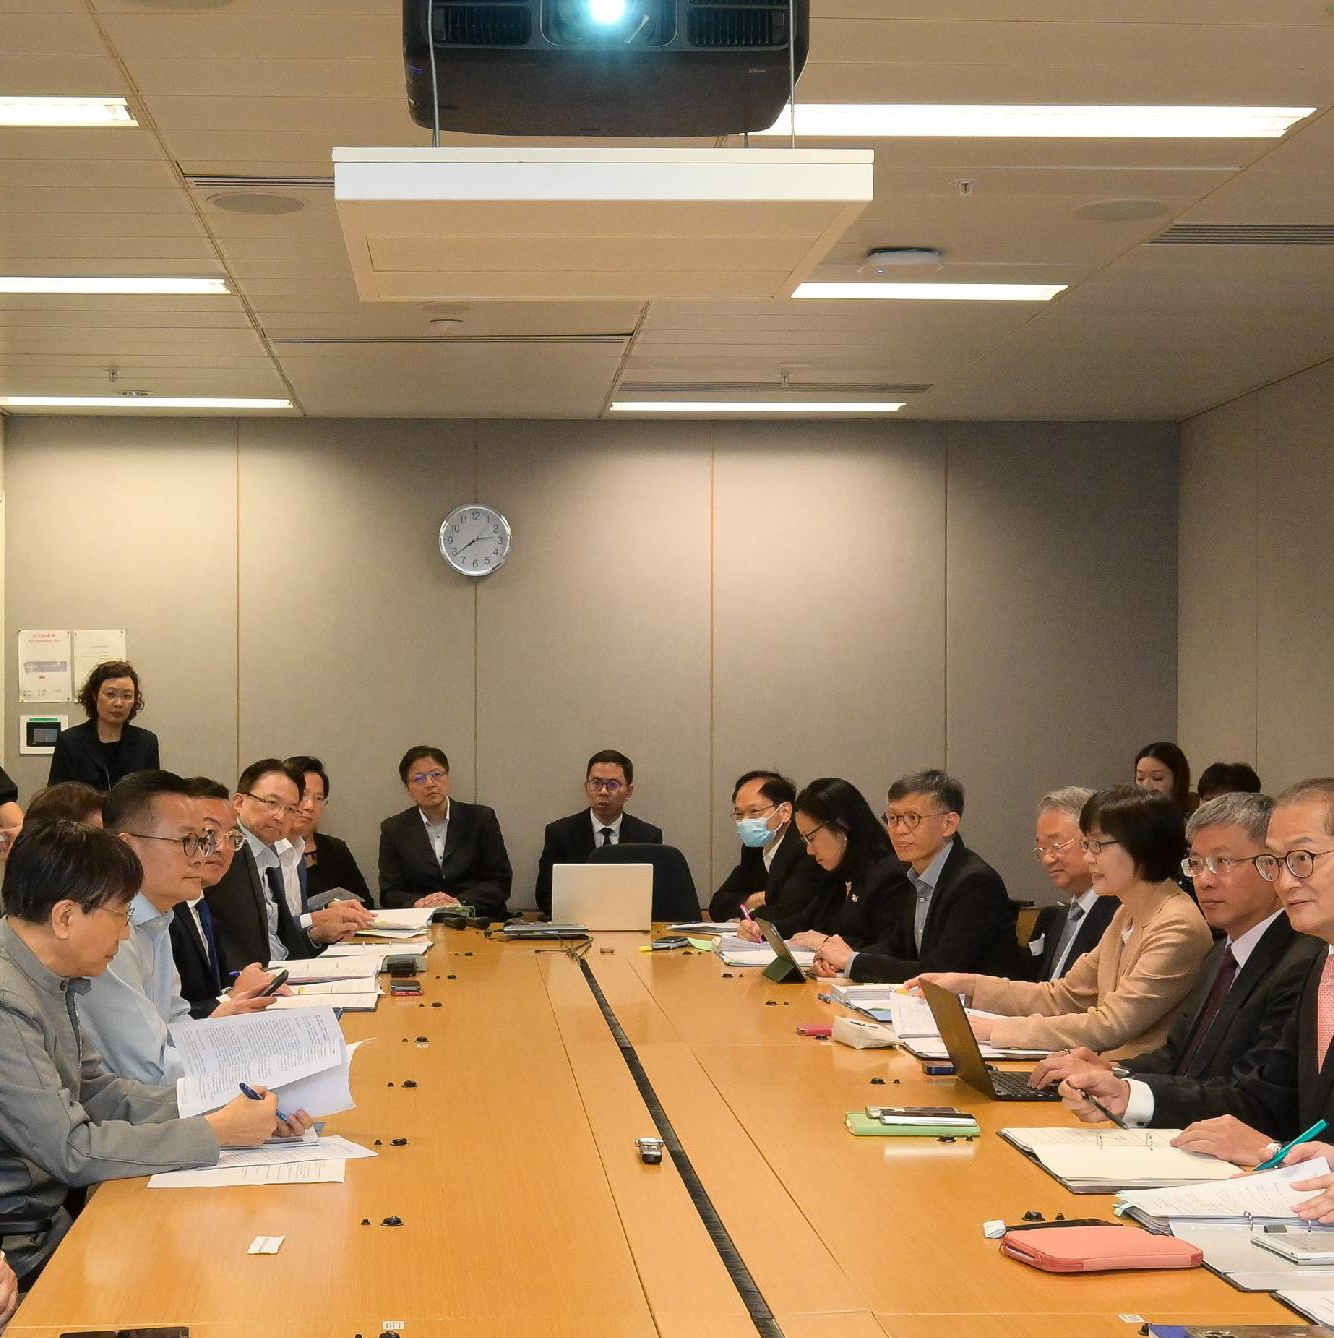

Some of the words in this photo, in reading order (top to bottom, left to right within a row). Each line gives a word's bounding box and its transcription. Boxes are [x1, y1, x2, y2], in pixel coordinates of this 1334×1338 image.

[472, 512, 481, 520] 12
[451, 524, 460, 533] 10
[493, 524, 499, 533] 2
[448, 536, 453, 545] 9
[498, 536, 503, 545] 3
[461, 556, 466, 564] 7
[472, 559, 478, 567] 6
[485, 556, 490, 564] 5
